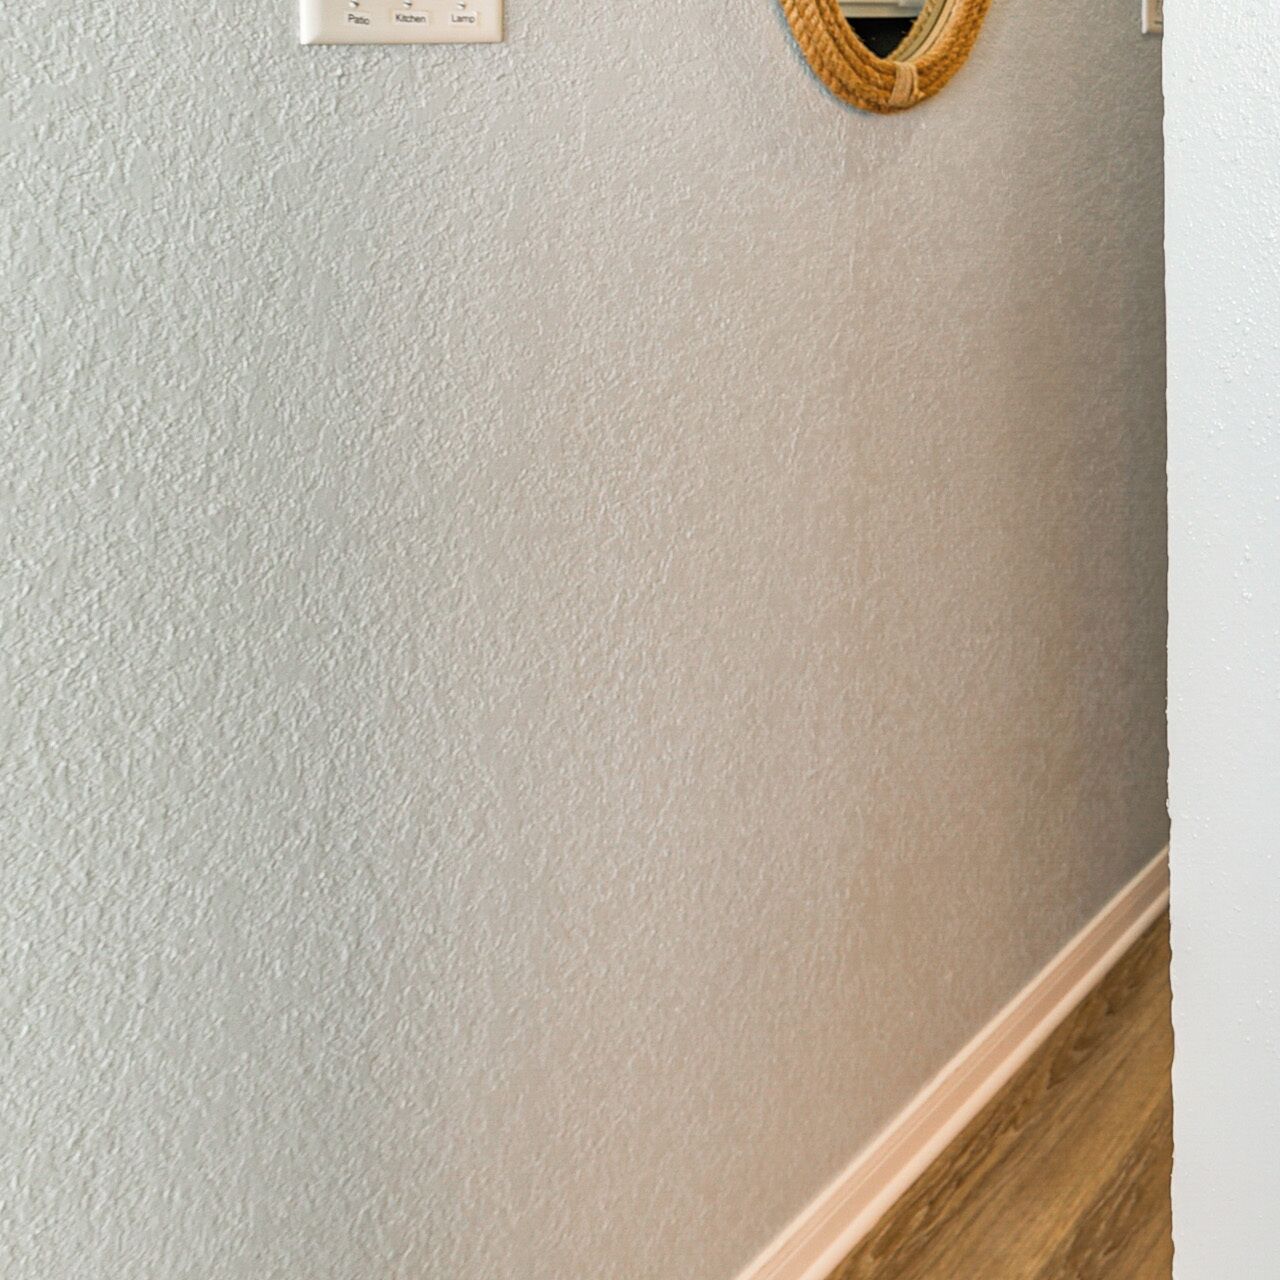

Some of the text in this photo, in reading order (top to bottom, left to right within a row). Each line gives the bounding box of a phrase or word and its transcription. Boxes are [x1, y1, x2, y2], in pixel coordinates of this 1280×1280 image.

[347, 13, 370, 25] Patio
[395, 13, 426, 24] Kitchen
[451, 13, 476, 25] Lamp
